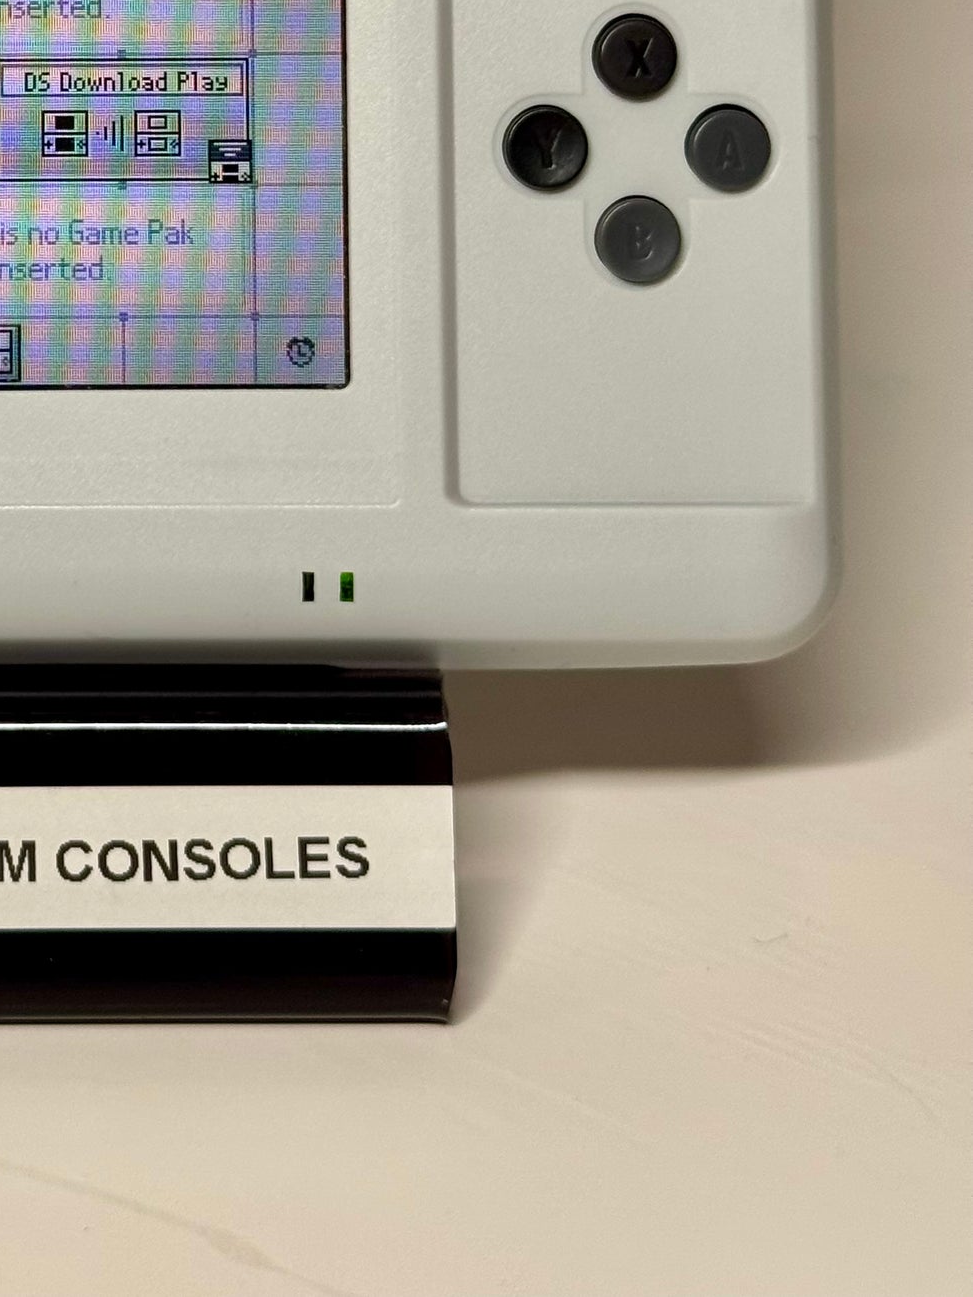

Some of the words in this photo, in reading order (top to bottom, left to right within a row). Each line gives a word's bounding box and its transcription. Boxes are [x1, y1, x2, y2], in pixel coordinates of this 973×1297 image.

[623, 38, 651, 79] X
[25, 72, 50, 92] DS
[60, 72, 167, 92] Download
[177, 72, 227, 91] Play
[530, 126, 561, 168] Y
[716, 129, 742, 171] A
[0, 223, 18, 246] is
[27, 228, 59, 245] no
[69, 219, 139, 245] Game
[147, 219, 193, 245] Pak
[56, 836, 370, 882] CONSOLES
